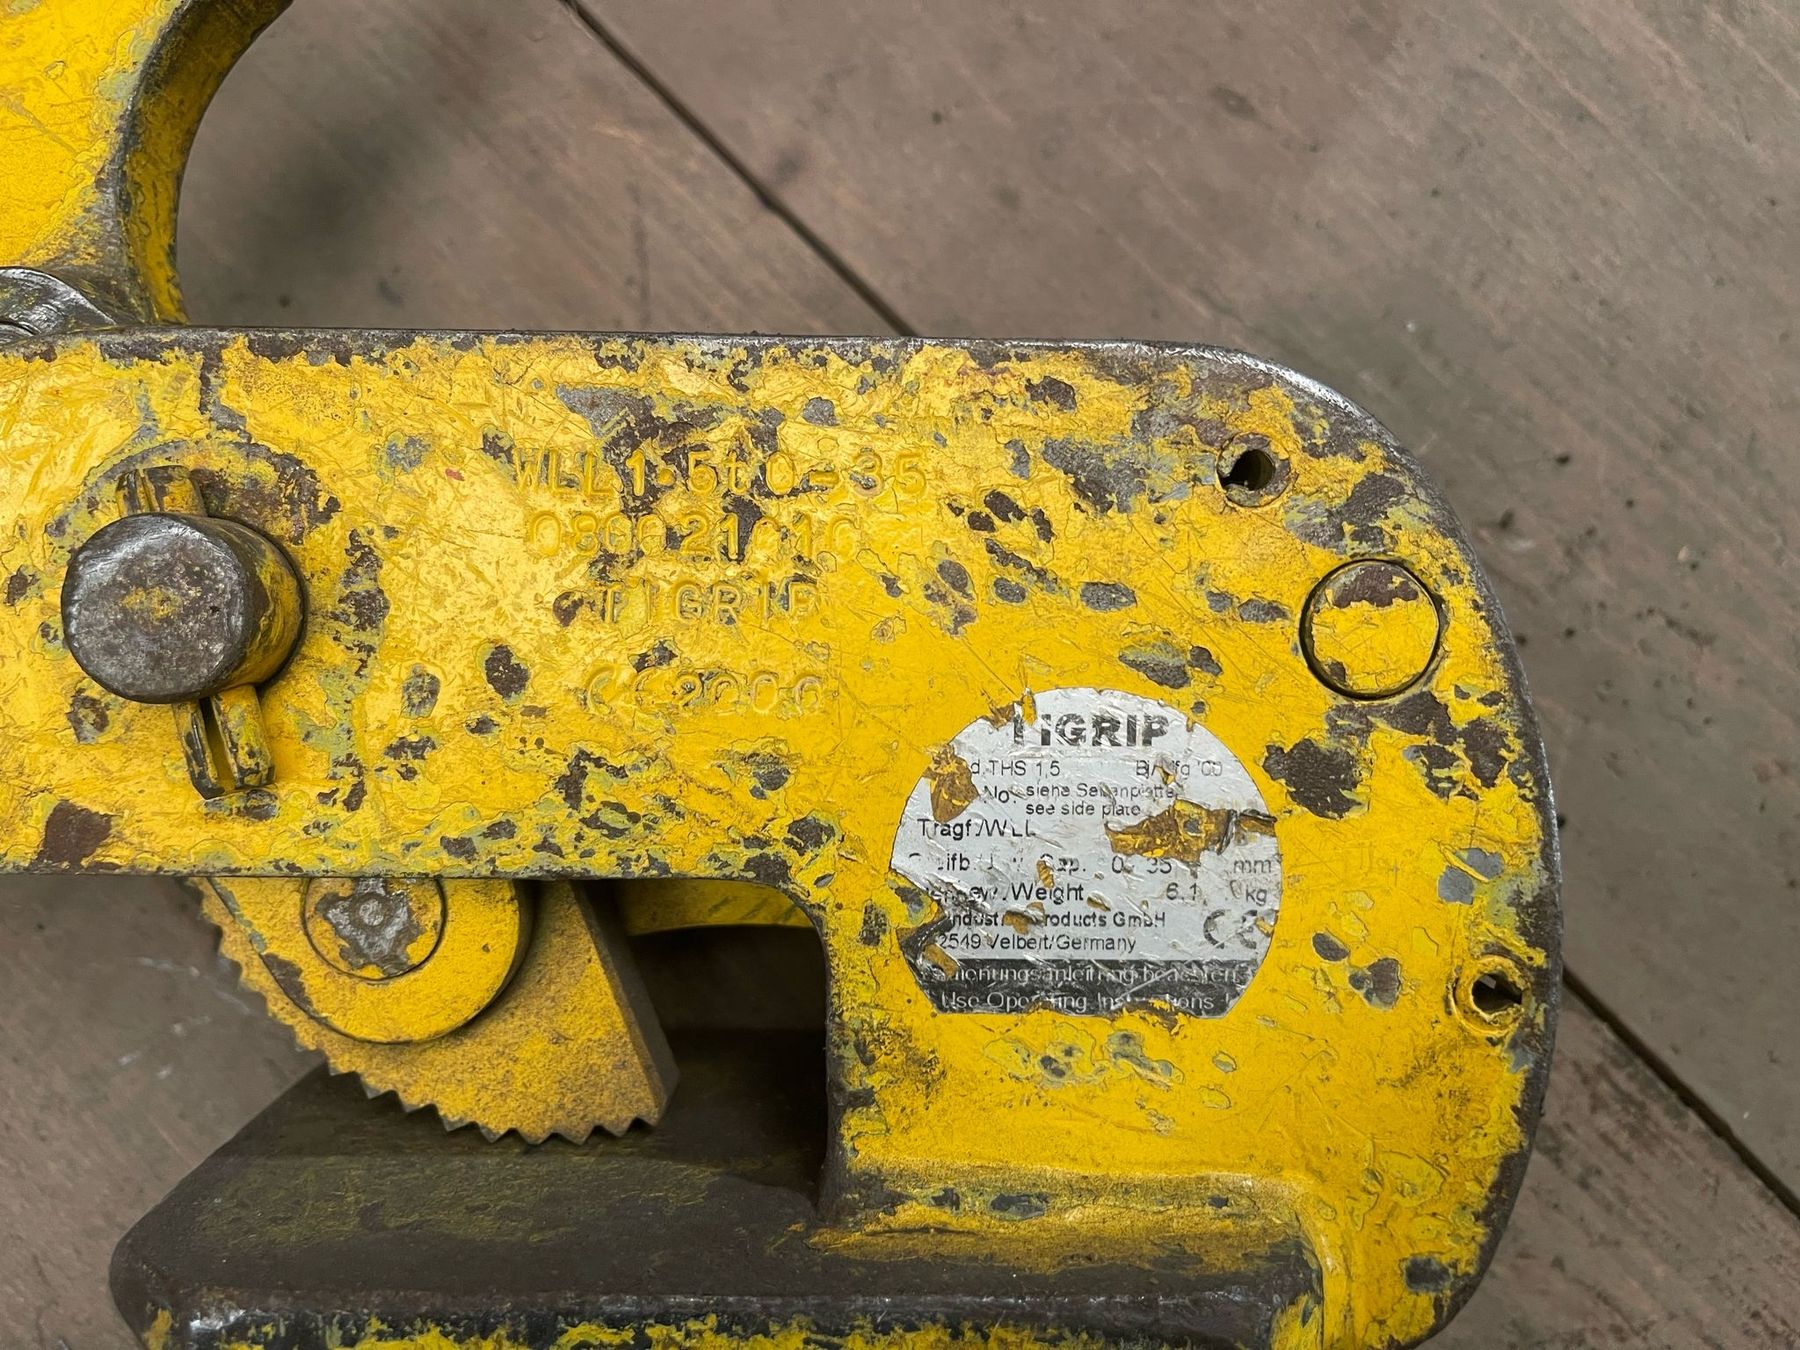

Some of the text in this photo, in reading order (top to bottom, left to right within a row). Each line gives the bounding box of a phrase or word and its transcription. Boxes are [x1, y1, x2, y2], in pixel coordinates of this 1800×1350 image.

[988, 759, 1026, 776] THS
[1026, 782, 1070, 797] siehe
[1026, 801, 1141, 819] see side plate
[1044, 911, 1107, 927] roducts
[938, 933, 981, 949] 2549
